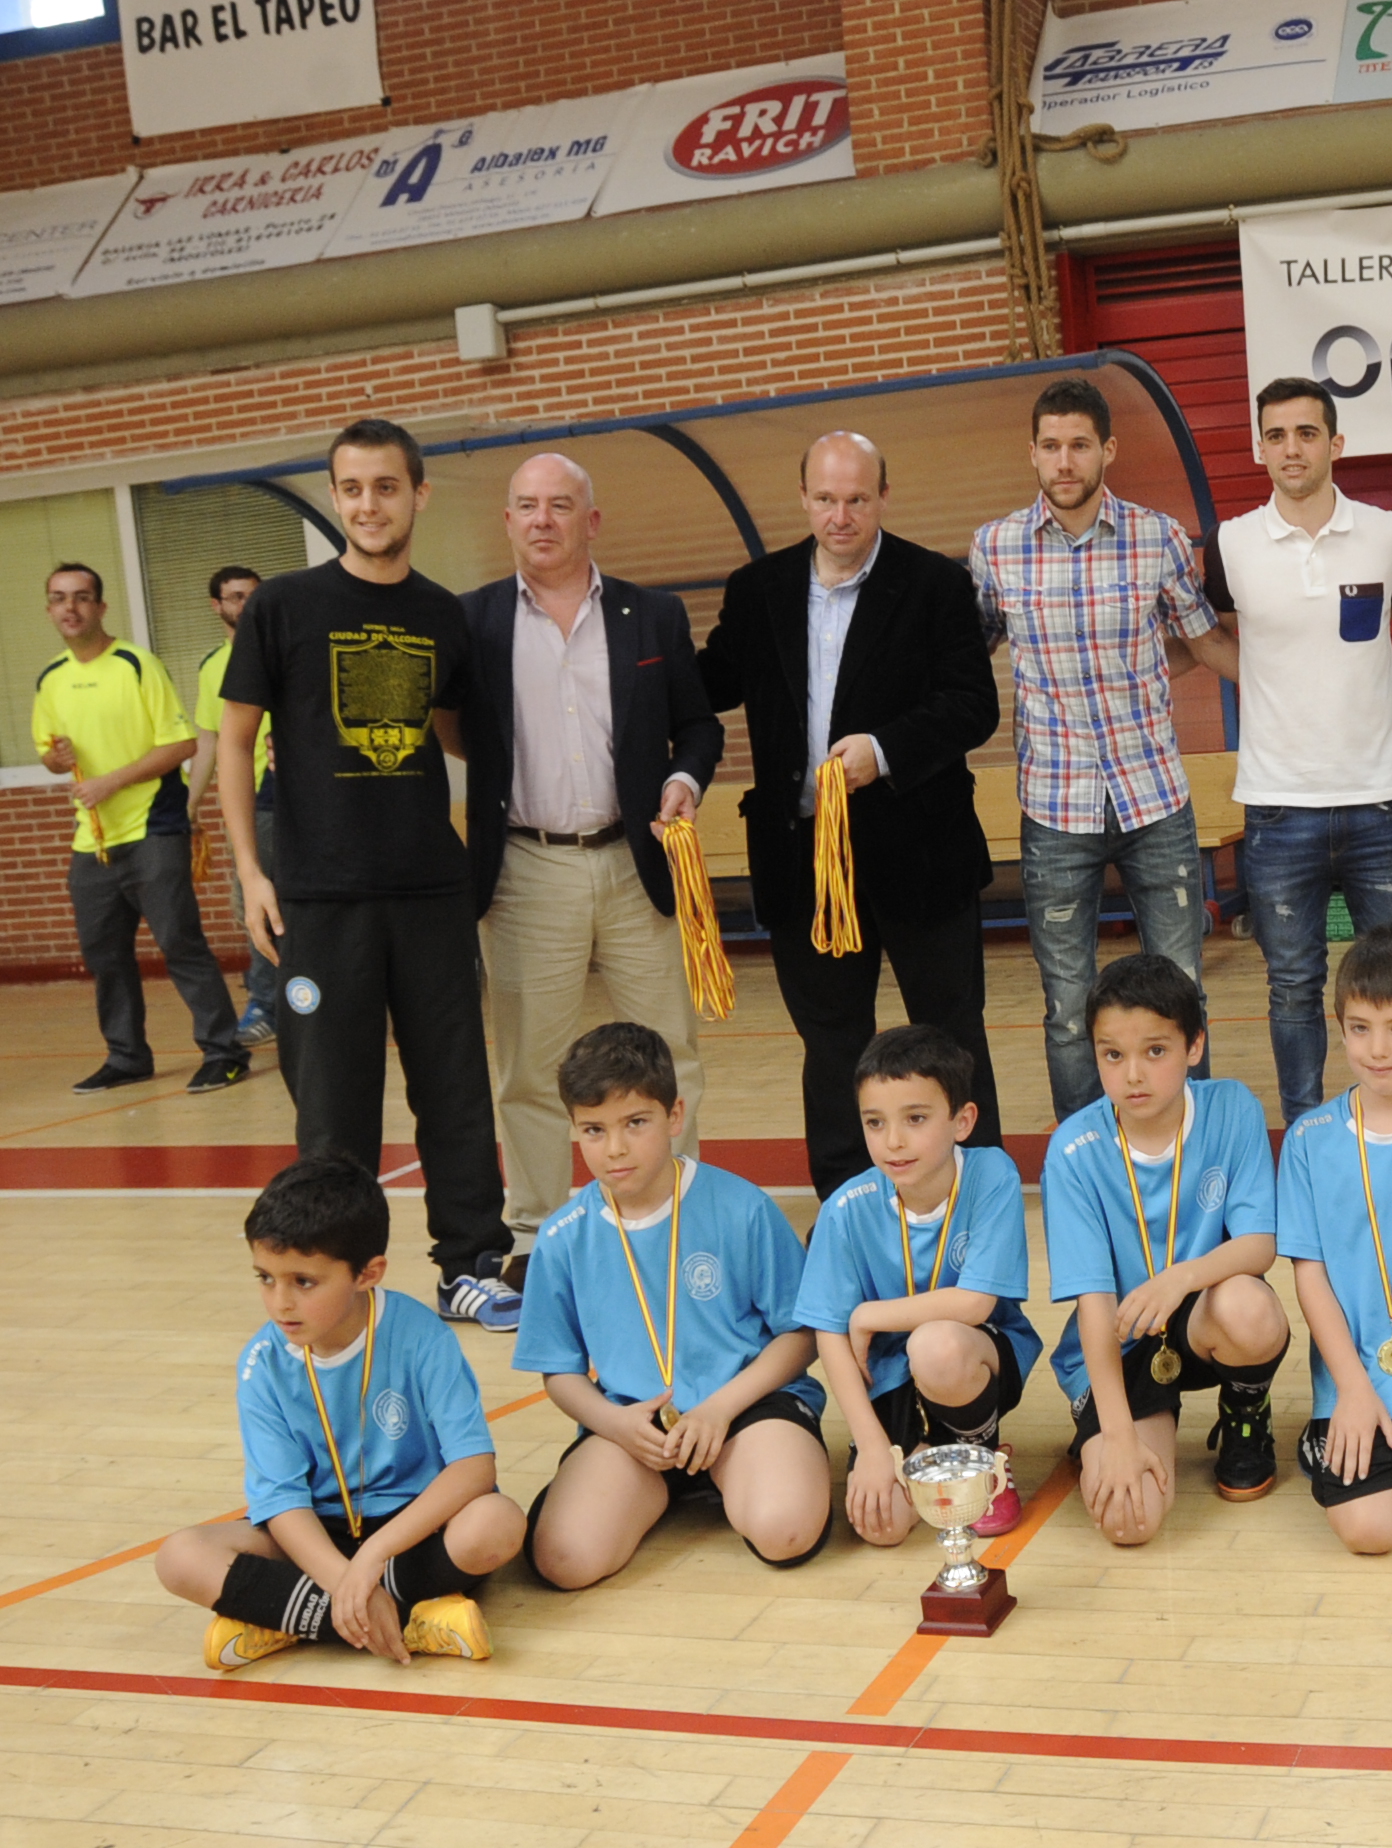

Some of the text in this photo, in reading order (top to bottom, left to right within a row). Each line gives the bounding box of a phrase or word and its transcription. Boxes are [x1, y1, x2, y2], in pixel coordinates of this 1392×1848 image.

[135, 9, 202, 54] BAR
[211, 1, 247, 43] EL
[1126, 80, 1211, 99] Logístico
[700, 88, 848, 144] FRIT
[470, 134, 608, 174] Albalex MG
[690, 129, 826, 167] RAVICH
[184, 147, 380, 199] IRRA & CARLOS
[201, 183, 324, 219] CARNICERIA
